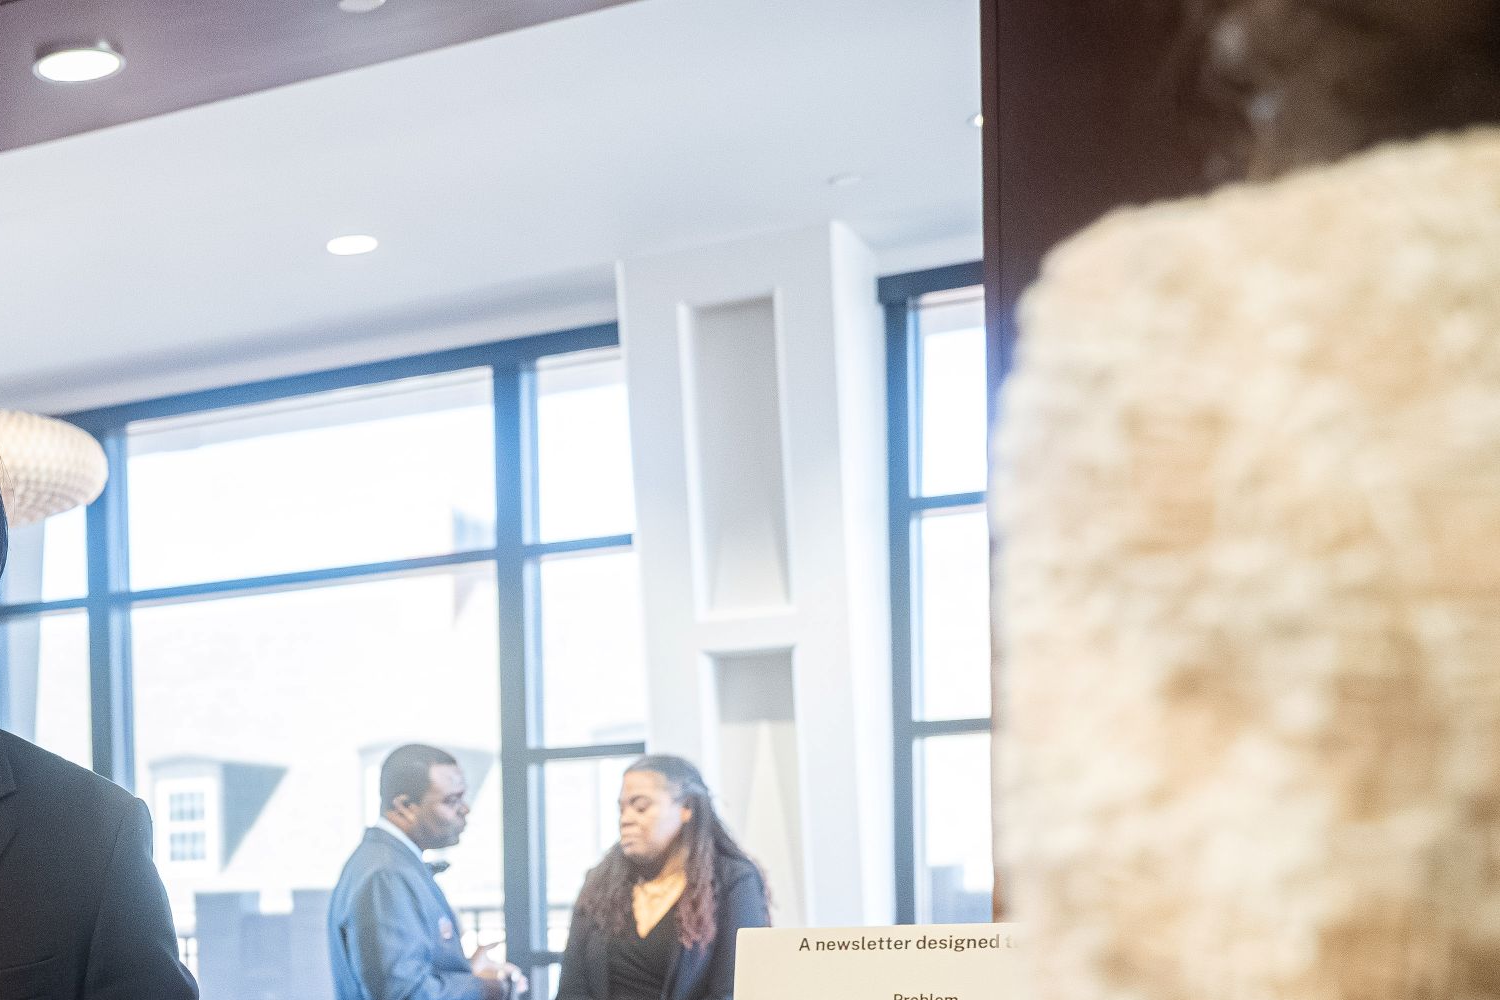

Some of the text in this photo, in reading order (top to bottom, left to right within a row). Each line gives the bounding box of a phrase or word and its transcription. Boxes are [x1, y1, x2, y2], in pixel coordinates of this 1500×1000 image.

[799, 937, 811, 951] A
[815, 936, 911, 951] newsletter
[916, 934, 1000, 952] designed
